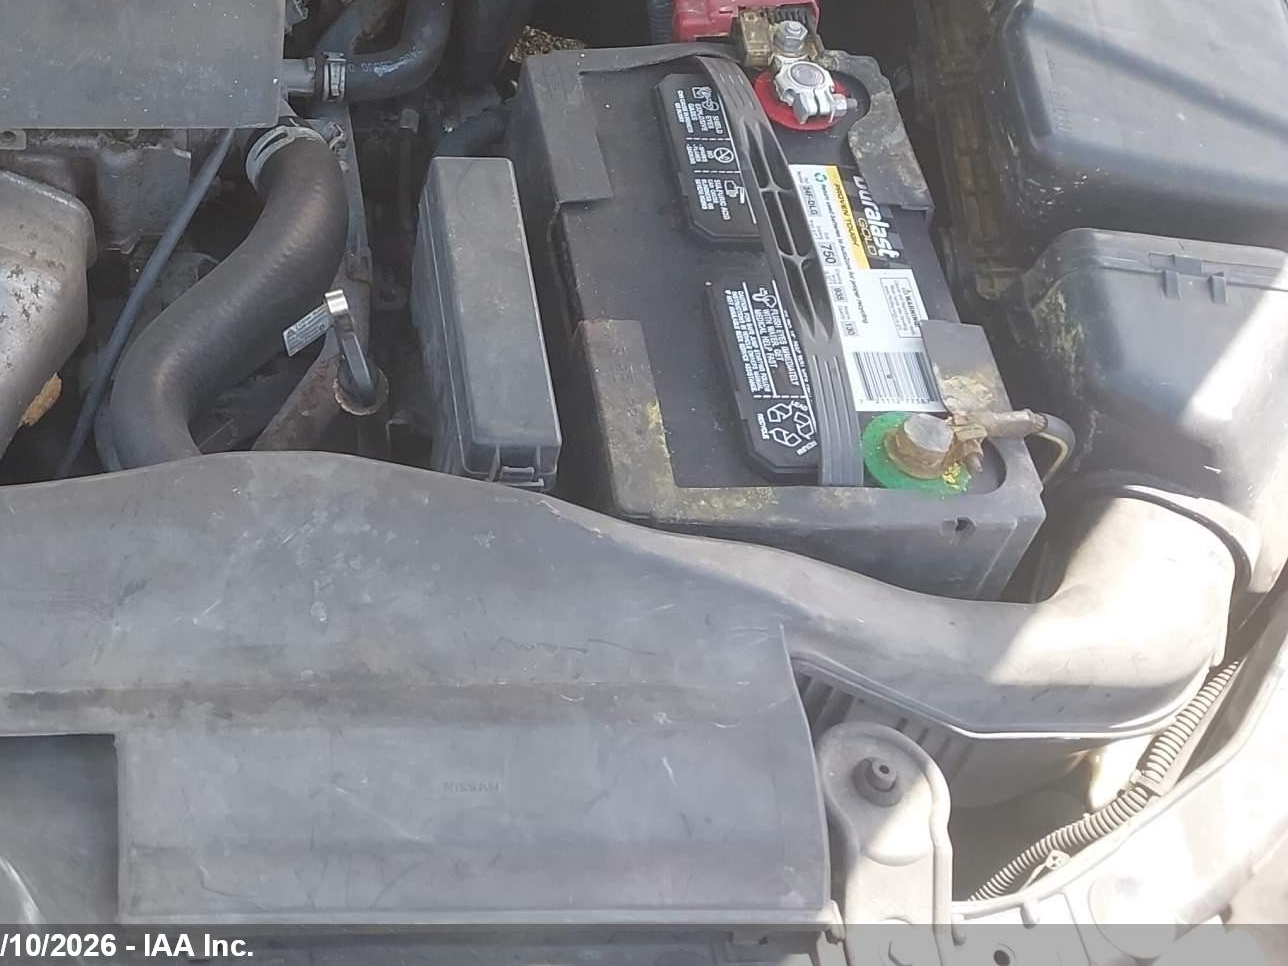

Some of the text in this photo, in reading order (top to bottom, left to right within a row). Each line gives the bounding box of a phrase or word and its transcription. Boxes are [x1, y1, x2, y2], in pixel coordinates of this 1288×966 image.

[834, 181, 859, 247] PROVEN TOUGH
[856, 216, 877, 257] GOLD
[820, 243, 836, 265] 750
[753, 308, 768, 334] MEDICAL
[761, 335, 773, 352] HELP
[769, 308, 782, 328] FLUSH
[844, 322, 855, 336] 130
[761, 308, 773, 324] WITH
[773, 348, 784, 362] GET
[775, 328, 787, 345] EYES
